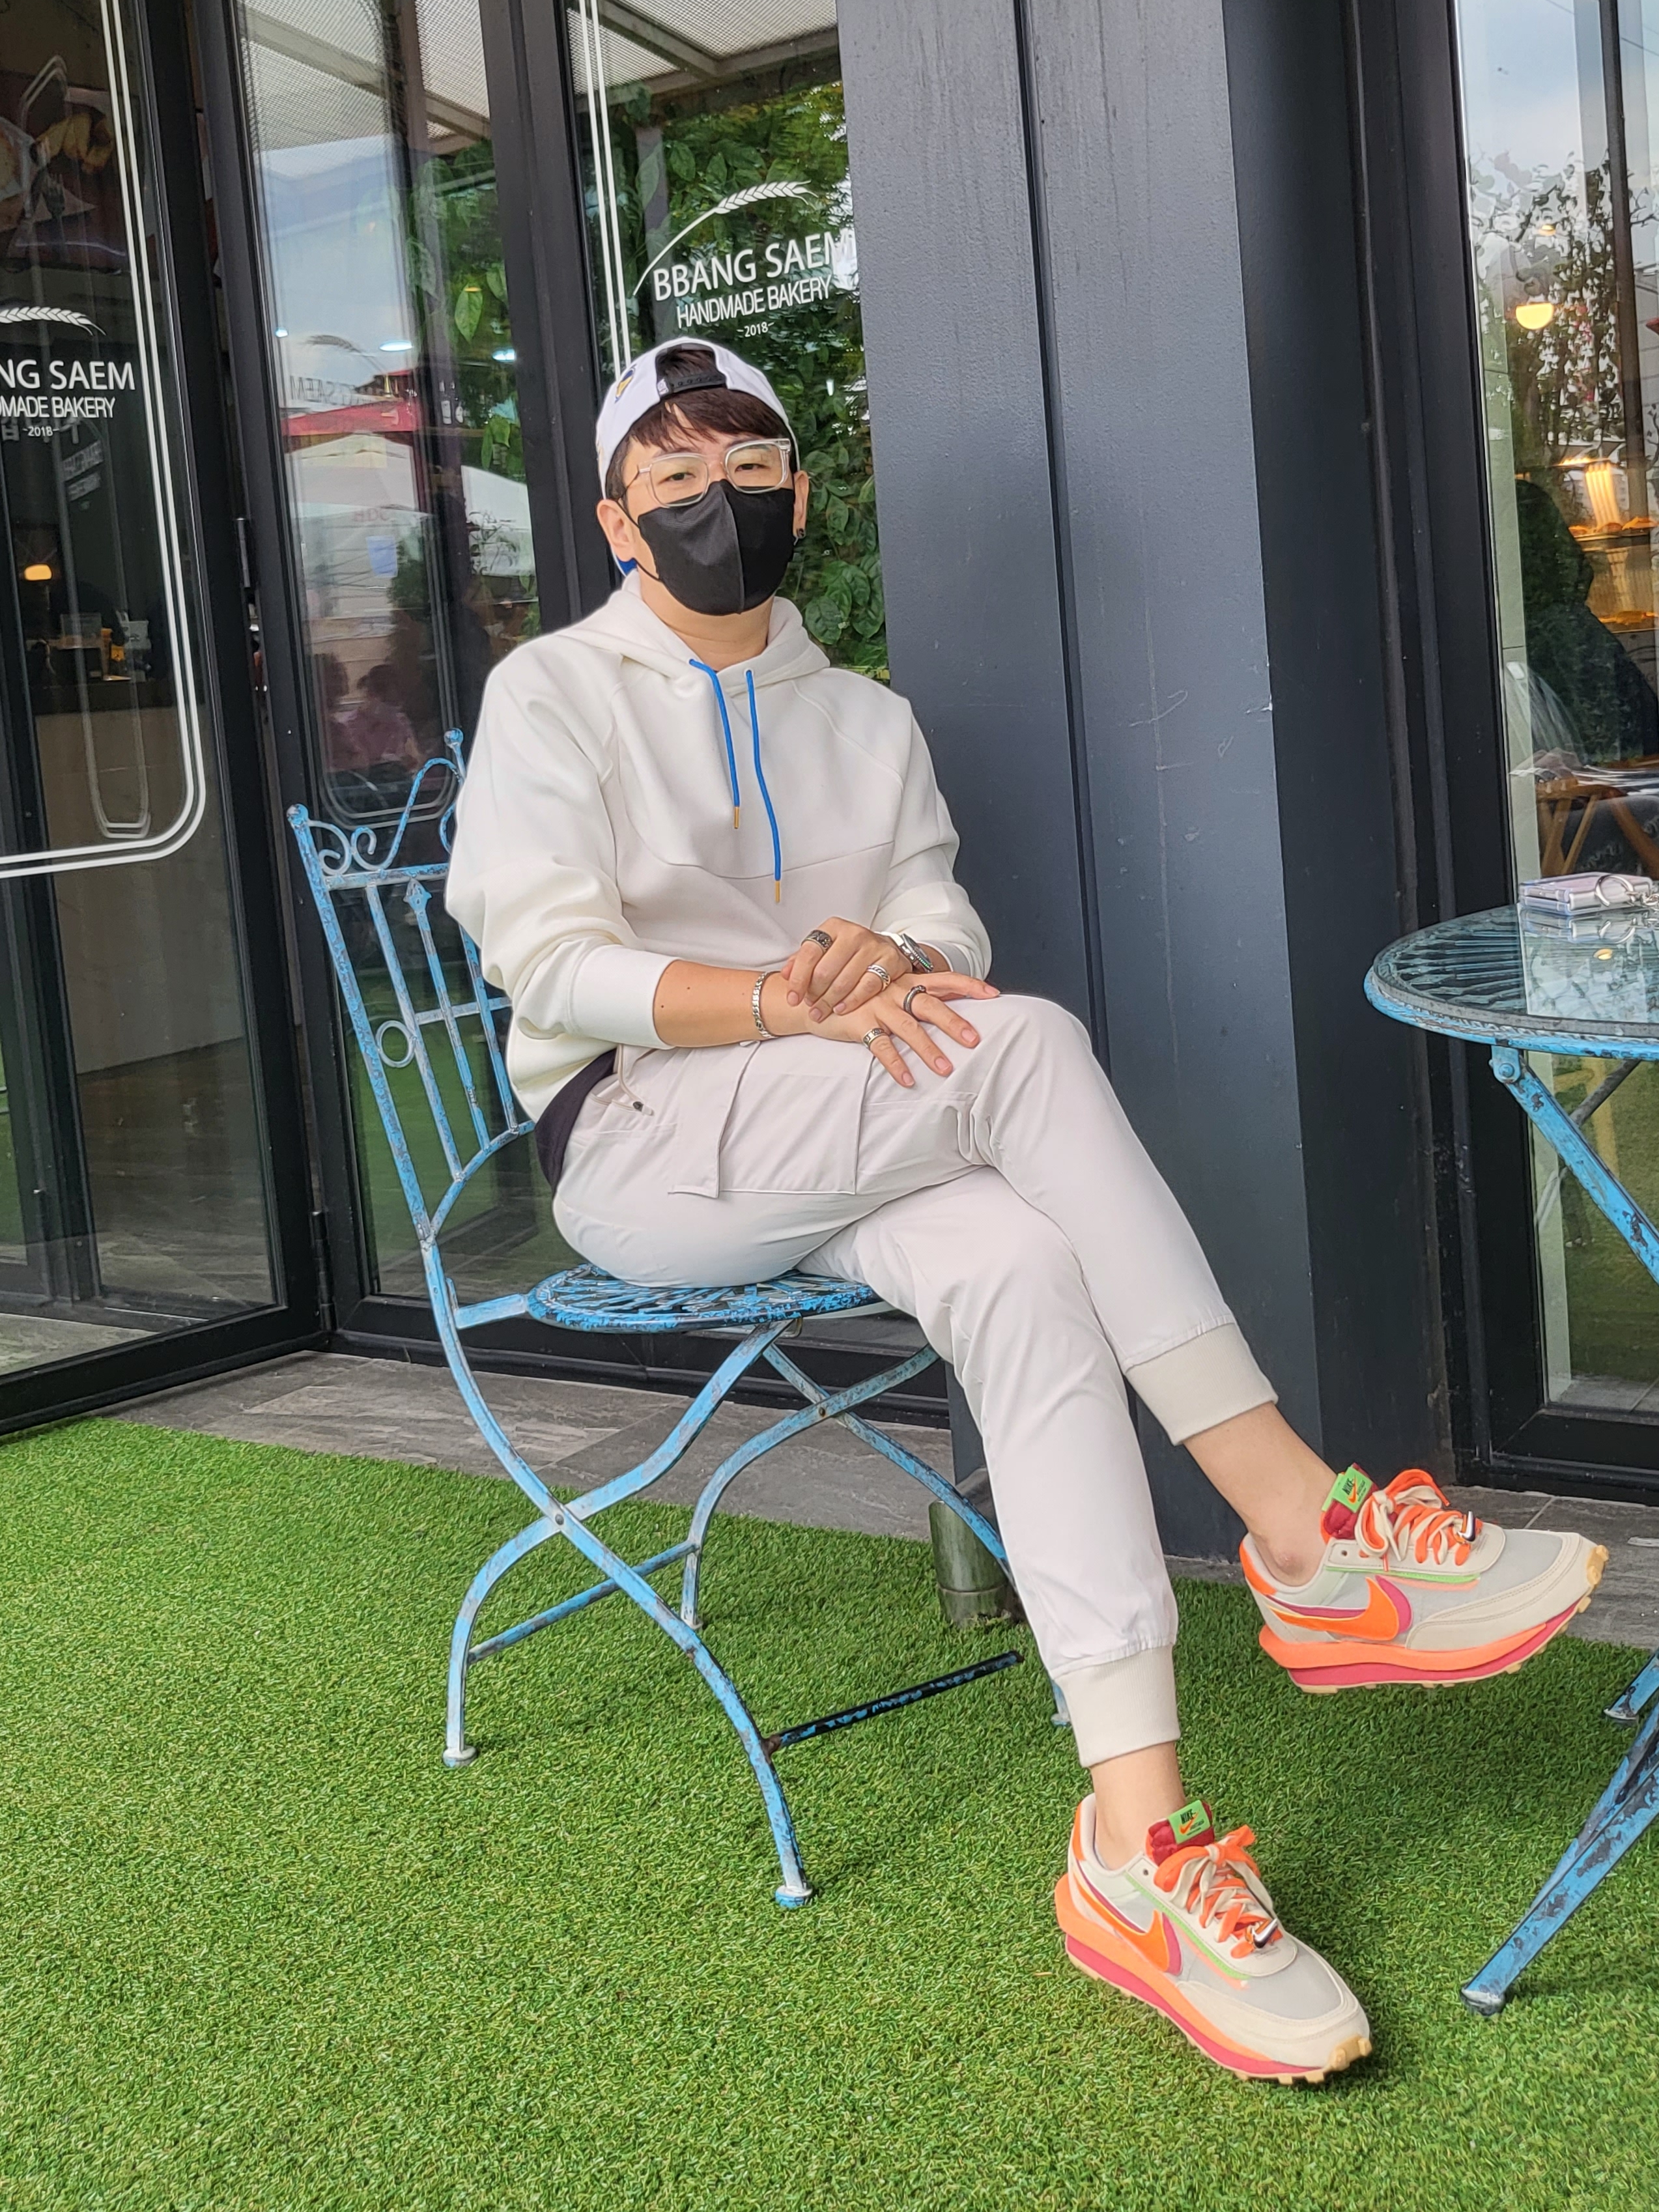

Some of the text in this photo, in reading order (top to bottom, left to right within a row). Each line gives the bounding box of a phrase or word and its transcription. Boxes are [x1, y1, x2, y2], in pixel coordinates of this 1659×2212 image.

[653, 249, 757, 301] BBANG
[677, 275, 832, 328] HANDMADE BAKERY
[49, 360, 135, 390] SAEM
[0, 395, 116, 418] MADE BAKERY
